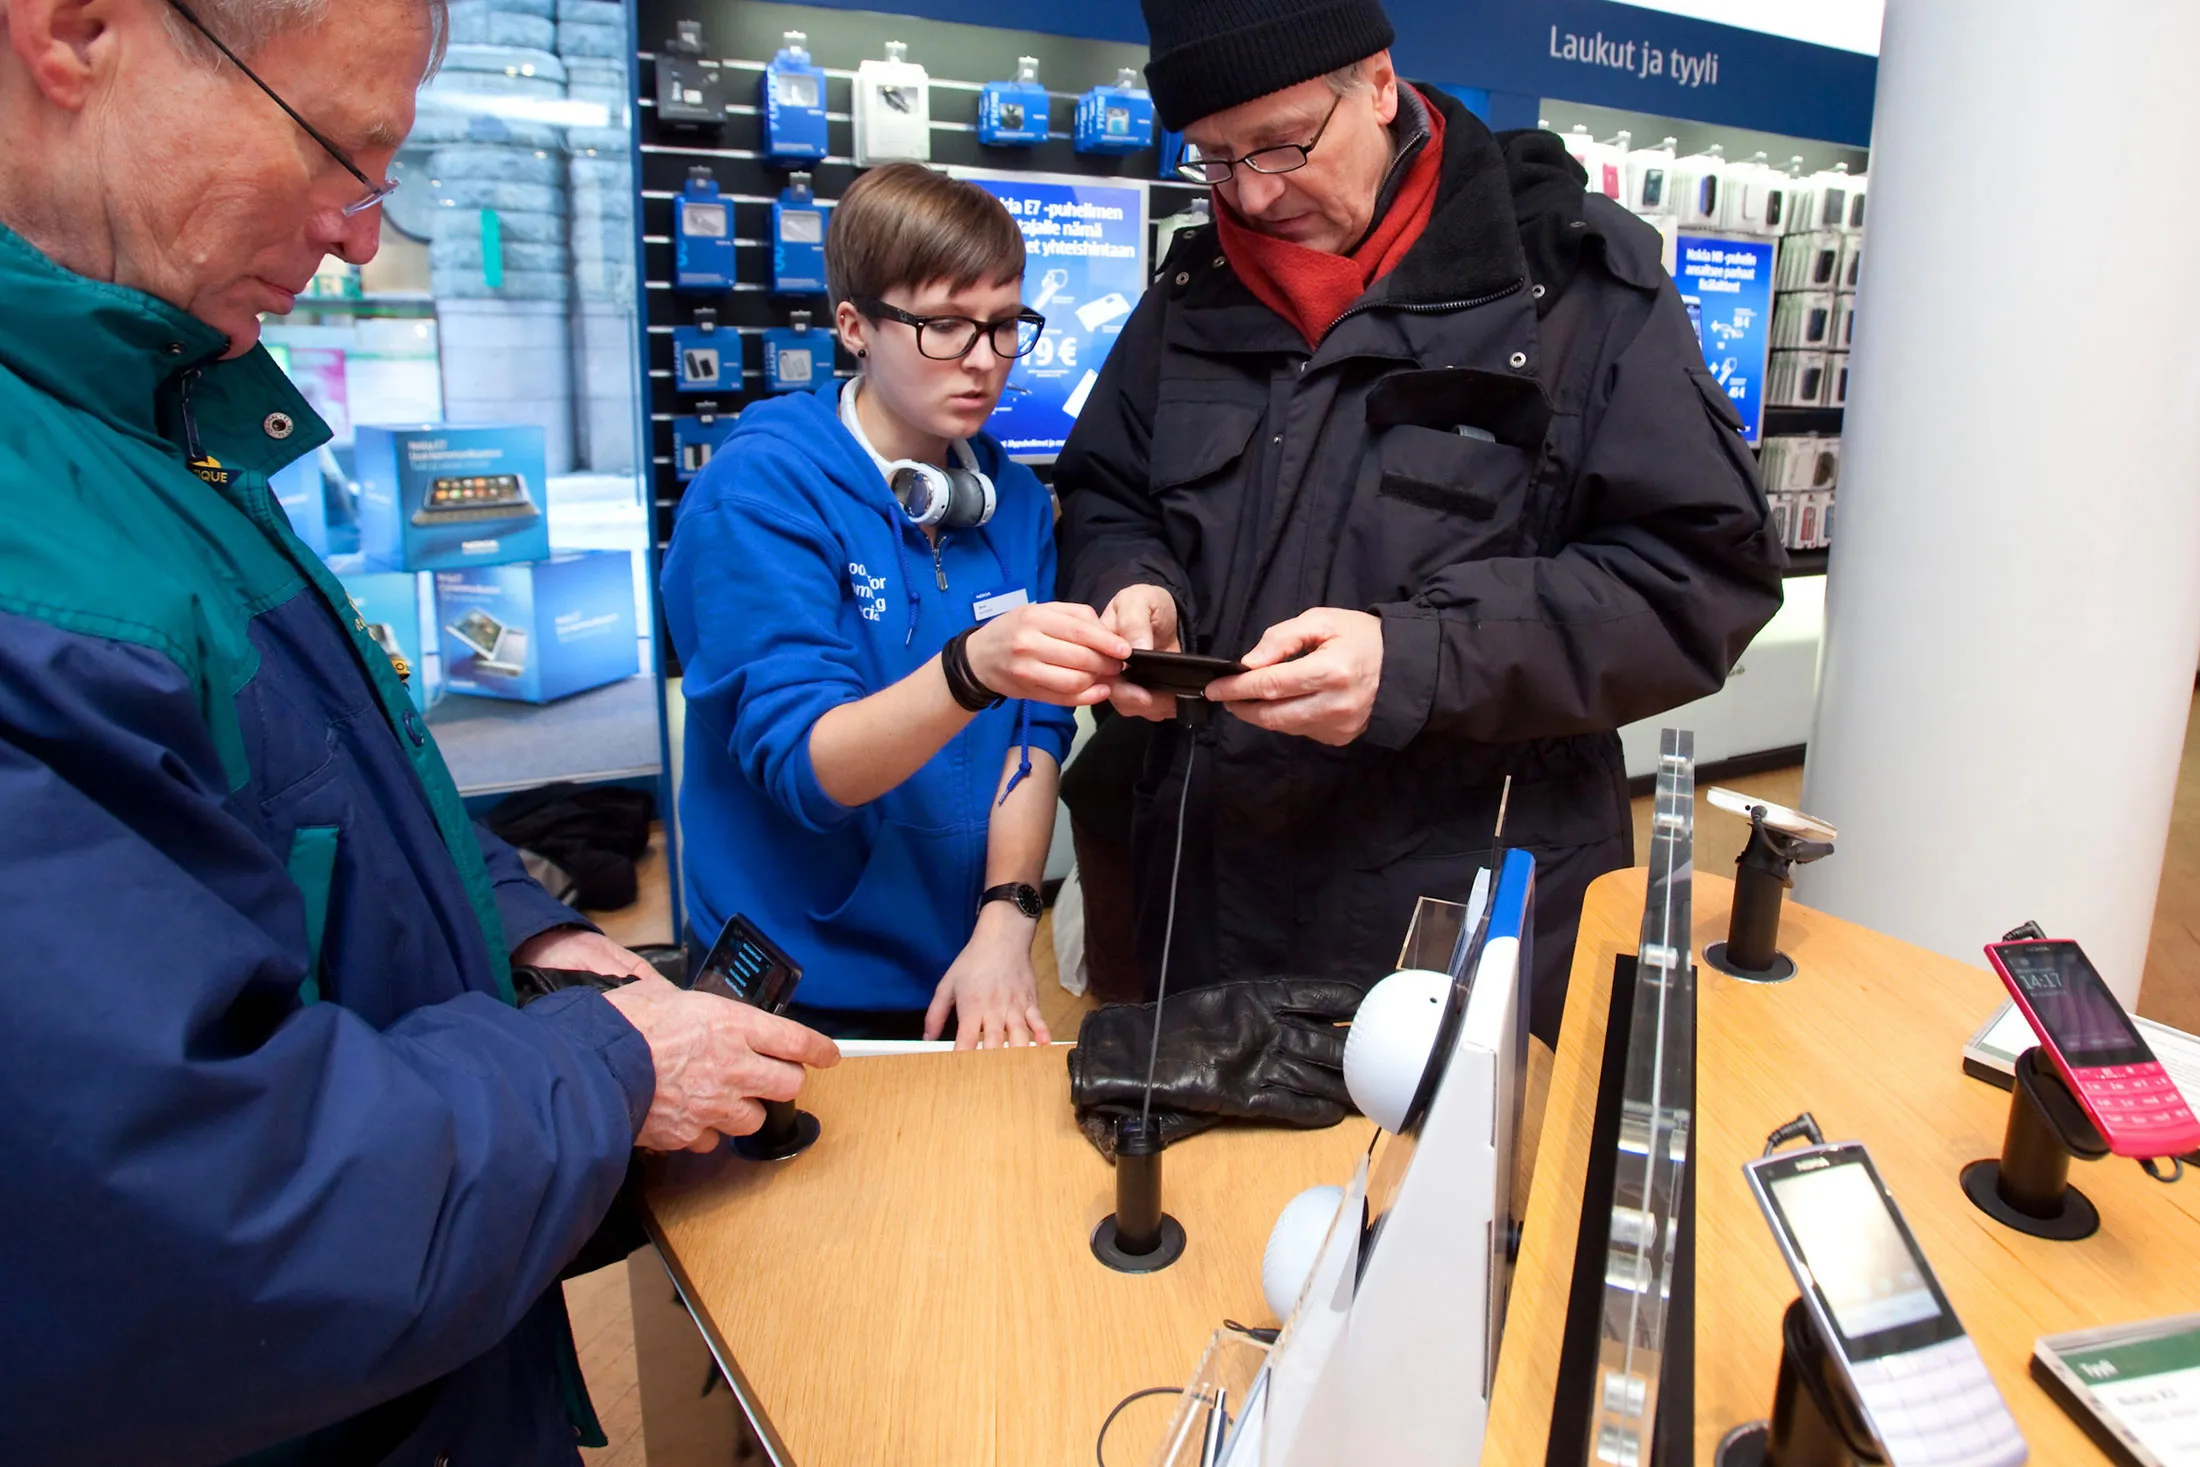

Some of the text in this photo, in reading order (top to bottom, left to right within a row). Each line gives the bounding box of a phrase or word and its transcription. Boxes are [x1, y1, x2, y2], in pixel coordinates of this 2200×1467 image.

[1549, 24, 1719, 88] Laukut ja tyyli
[1024, 199, 1042, 216] E7
[1043, 200, 1124, 221] -puhelimen
[1017, 218, 1103, 238] tajalle nämä
[1042, 239, 1136, 258] yhteishintaan
[1057, 336, 1077, 366] €
[2018, 972, 2063, 991] 14:17
